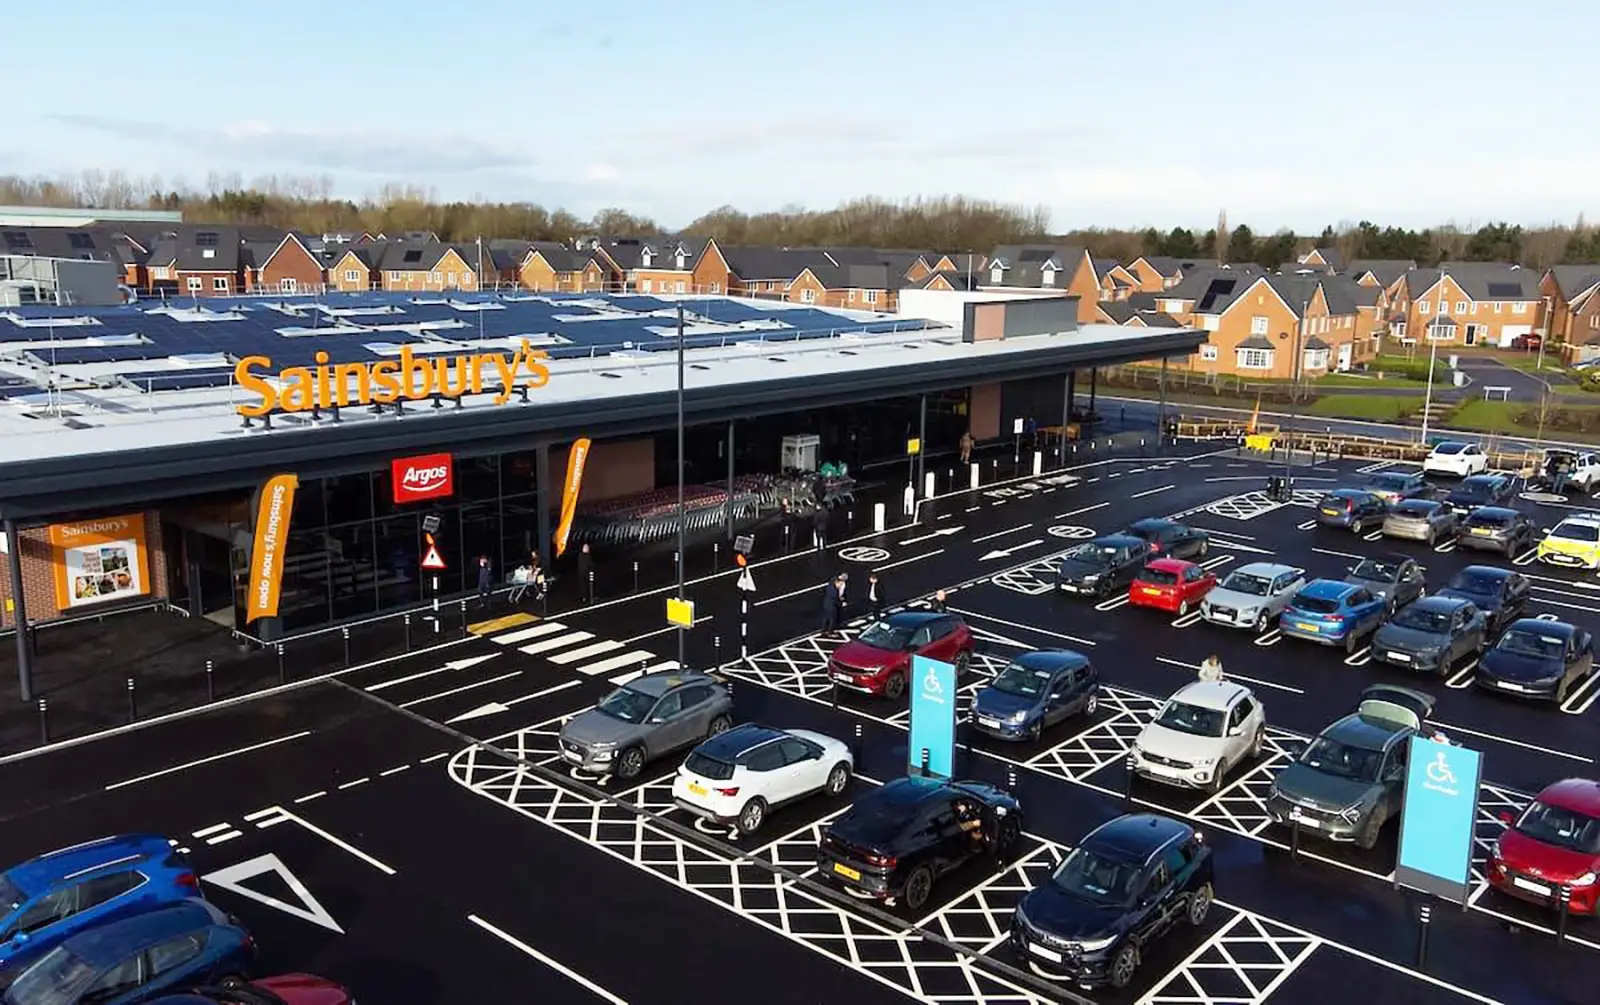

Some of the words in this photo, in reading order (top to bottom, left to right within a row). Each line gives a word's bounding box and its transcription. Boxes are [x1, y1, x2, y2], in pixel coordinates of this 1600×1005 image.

[234, 338, 550, 416] Sainsbury's
[402, 466, 448, 485] Argos
[62, 520, 129, 537] Sainsbury's
[264, 484, 286, 552] Sainsbury's
[262, 553, 273, 578] now
[258, 579, 270, 609] open
